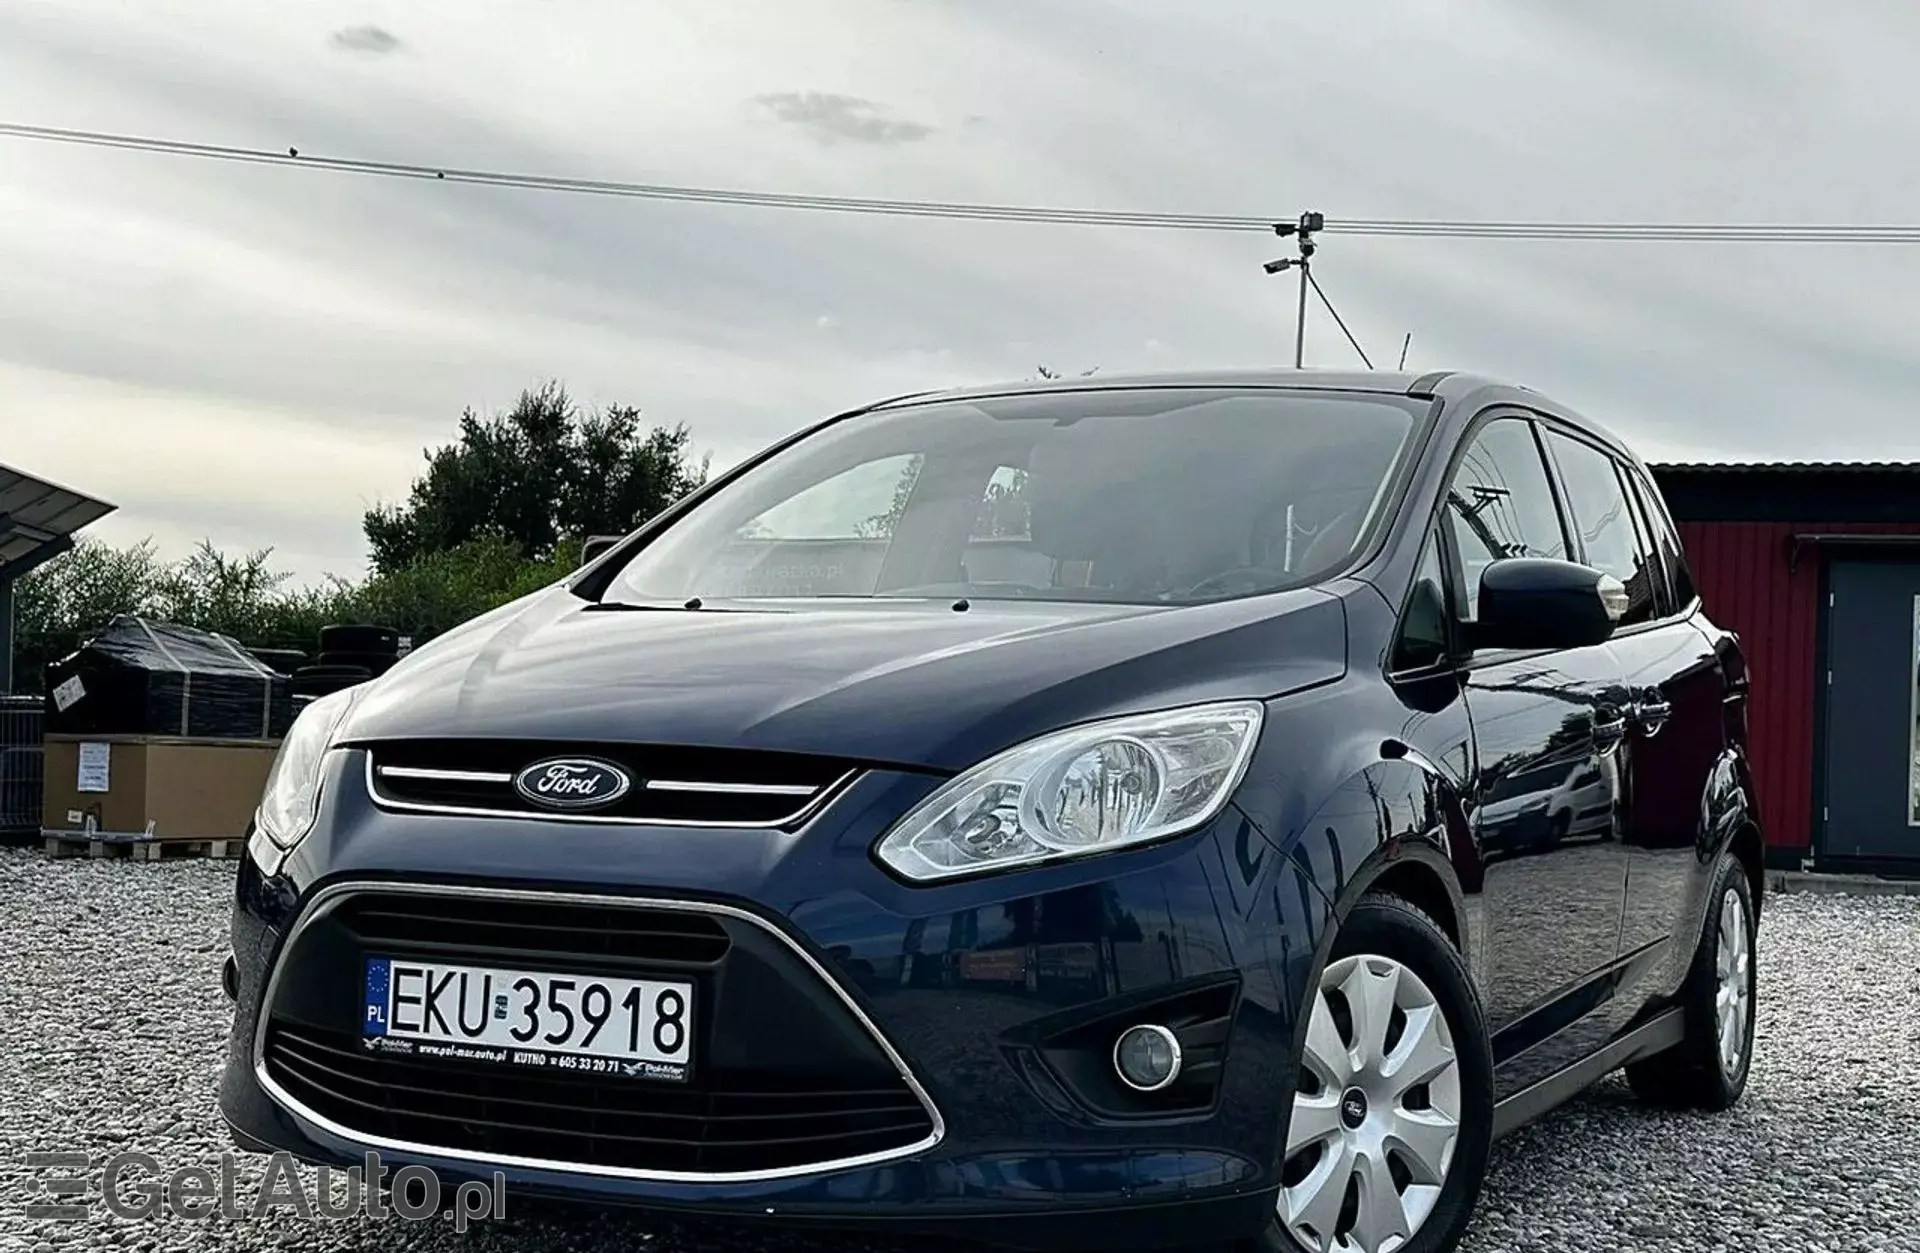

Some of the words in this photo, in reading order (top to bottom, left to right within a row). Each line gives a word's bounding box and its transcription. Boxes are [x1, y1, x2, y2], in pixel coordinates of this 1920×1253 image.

[537, 764, 602, 795] Ford
[367, 1004, 386, 1023] PL
[390, 966, 492, 1038] EKU
[509, 977, 685, 1055] 35918
[559, 1056, 577, 1069] 605
[578, 1057, 591, 1070] 33
[592, 1059, 606, 1072] 20
[607, 1060, 620, 1073] 71
